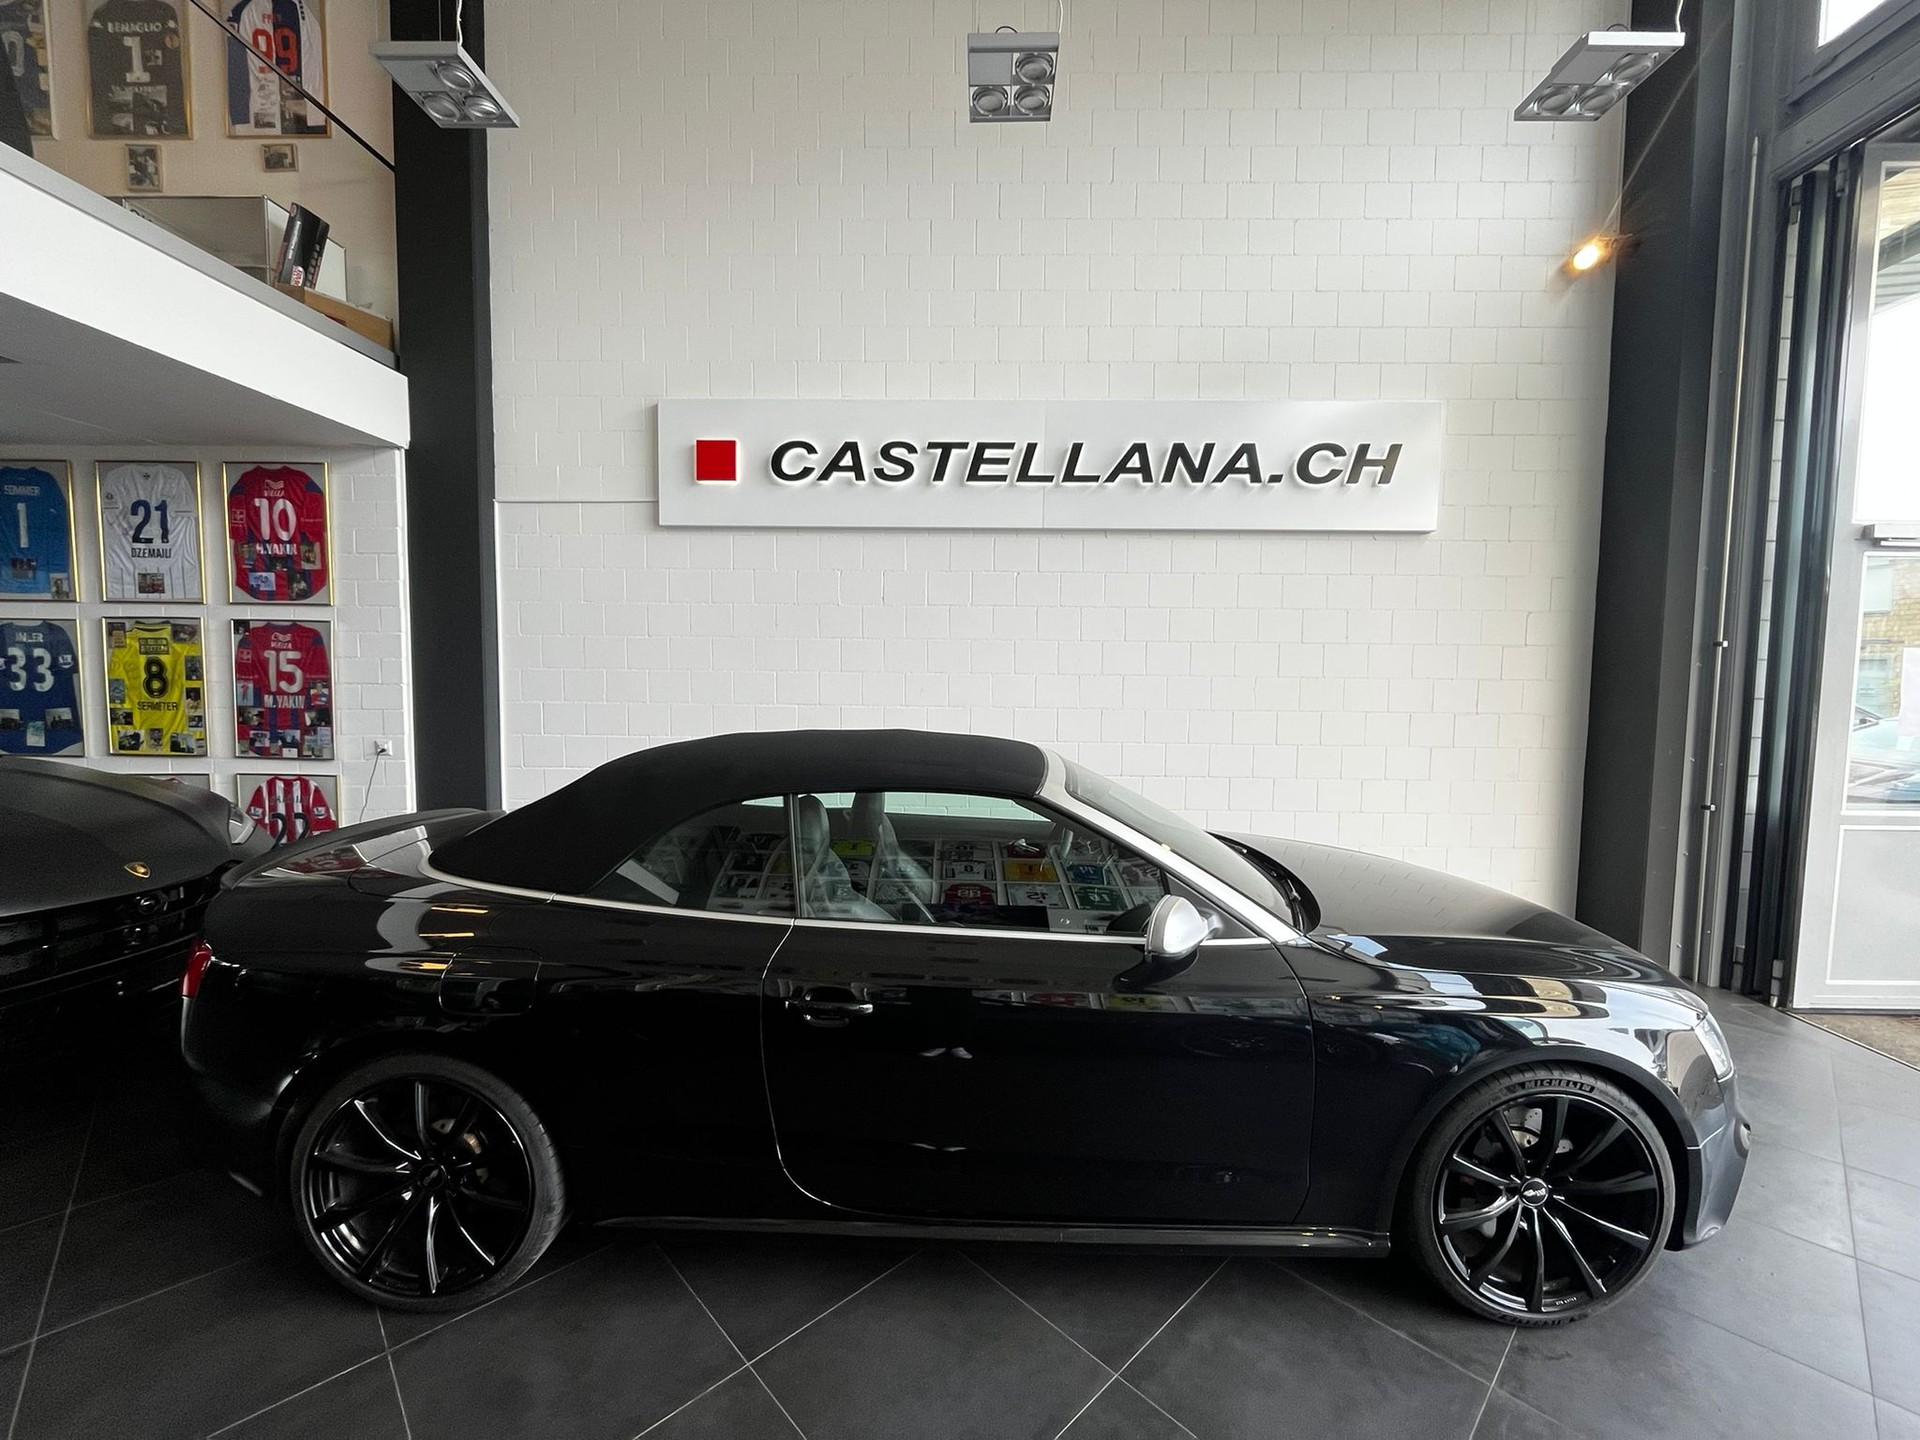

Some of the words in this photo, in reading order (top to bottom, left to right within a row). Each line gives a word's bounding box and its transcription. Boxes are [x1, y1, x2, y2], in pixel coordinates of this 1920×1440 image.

[108, 22, 162, 33] BENAGLIO
[123, 36, 151, 82] 1
[252, 27, 298, 75] 99
[769, 440, 1404, 486] CASTELLANA.CH
[4, 485, 40, 496] SOMMER
[17, 502, 29, 548] 1
[130, 499, 170, 544] 21
[254, 497, 297, 541] 10
[15, 632, 44, 643] INLER
[7, 646, 54, 692] 33
[143, 657, 170, 699] 8
[264, 650, 304, 694] 15
[137, 701, 179, 712] SERMETER
[1524, 1079, 1593, 1093] MICHELIN
